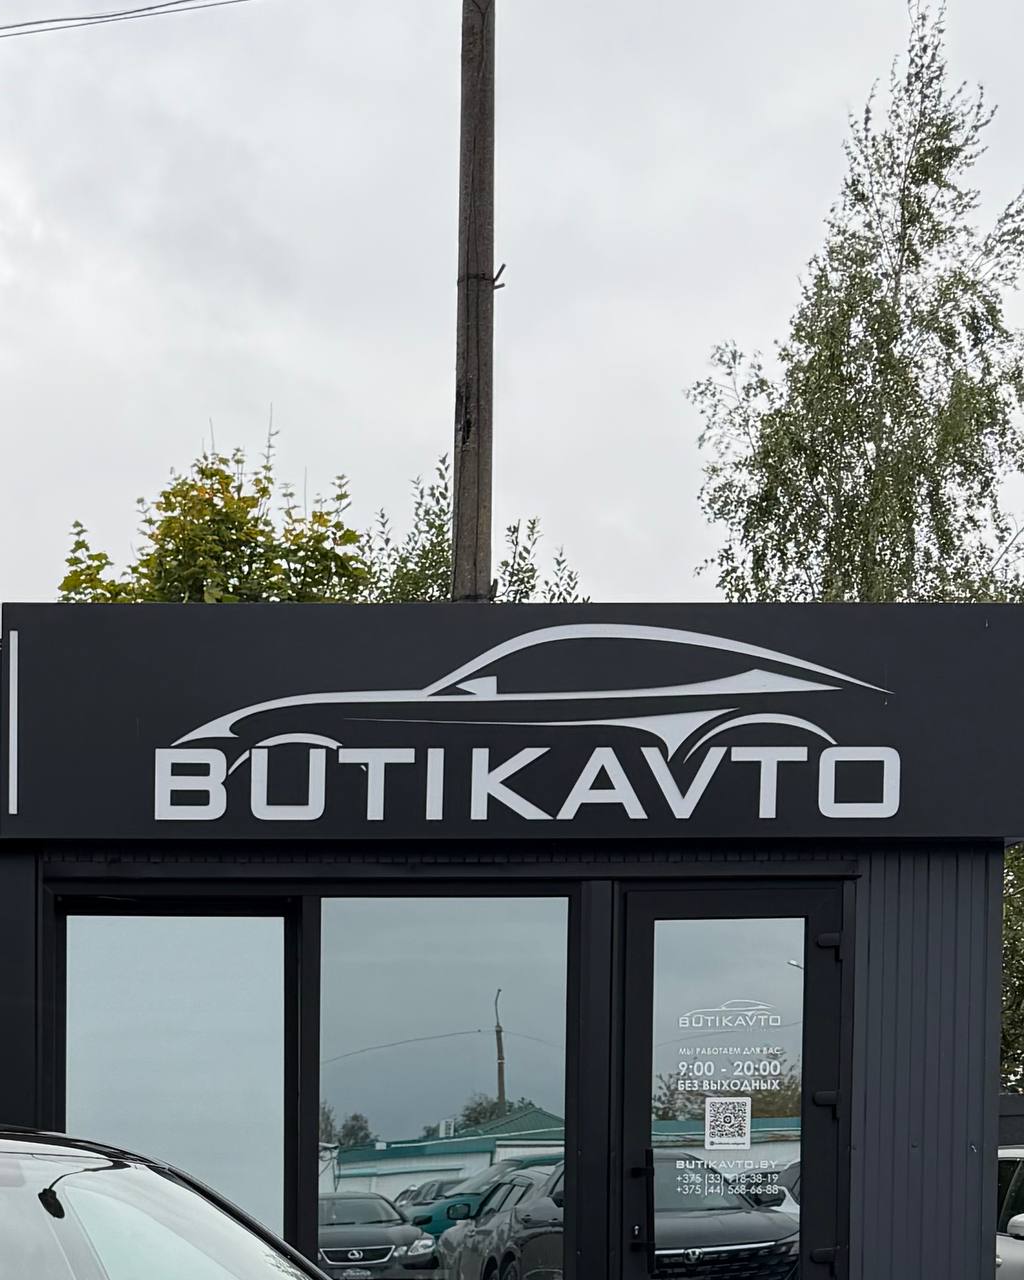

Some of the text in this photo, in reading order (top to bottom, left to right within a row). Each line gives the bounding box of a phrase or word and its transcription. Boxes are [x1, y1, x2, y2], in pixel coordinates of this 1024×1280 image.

[154, 746, 901, 821] BUTIKAVTO
[678, 1015, 781, 1027] BUTIKAVTO
[678, 1047, 694, 1056] МЫ
[696, 1047, 741, 1056] РАБОТАЕМ
[678, 1061, 715, 1076] 9:00
[733, 1060, 781, 1076] 20:00
[677, 1079, 781, 1091] БЕЗ ВЫХОДНЫХ
[676, 1160, 778, 1169] BUTIKAVTO.BY
[676, 1172, 779, 1184] +375 (33) 18-38-19
[676, 1184, 779, 1196] +375 (44) 568-66-88
